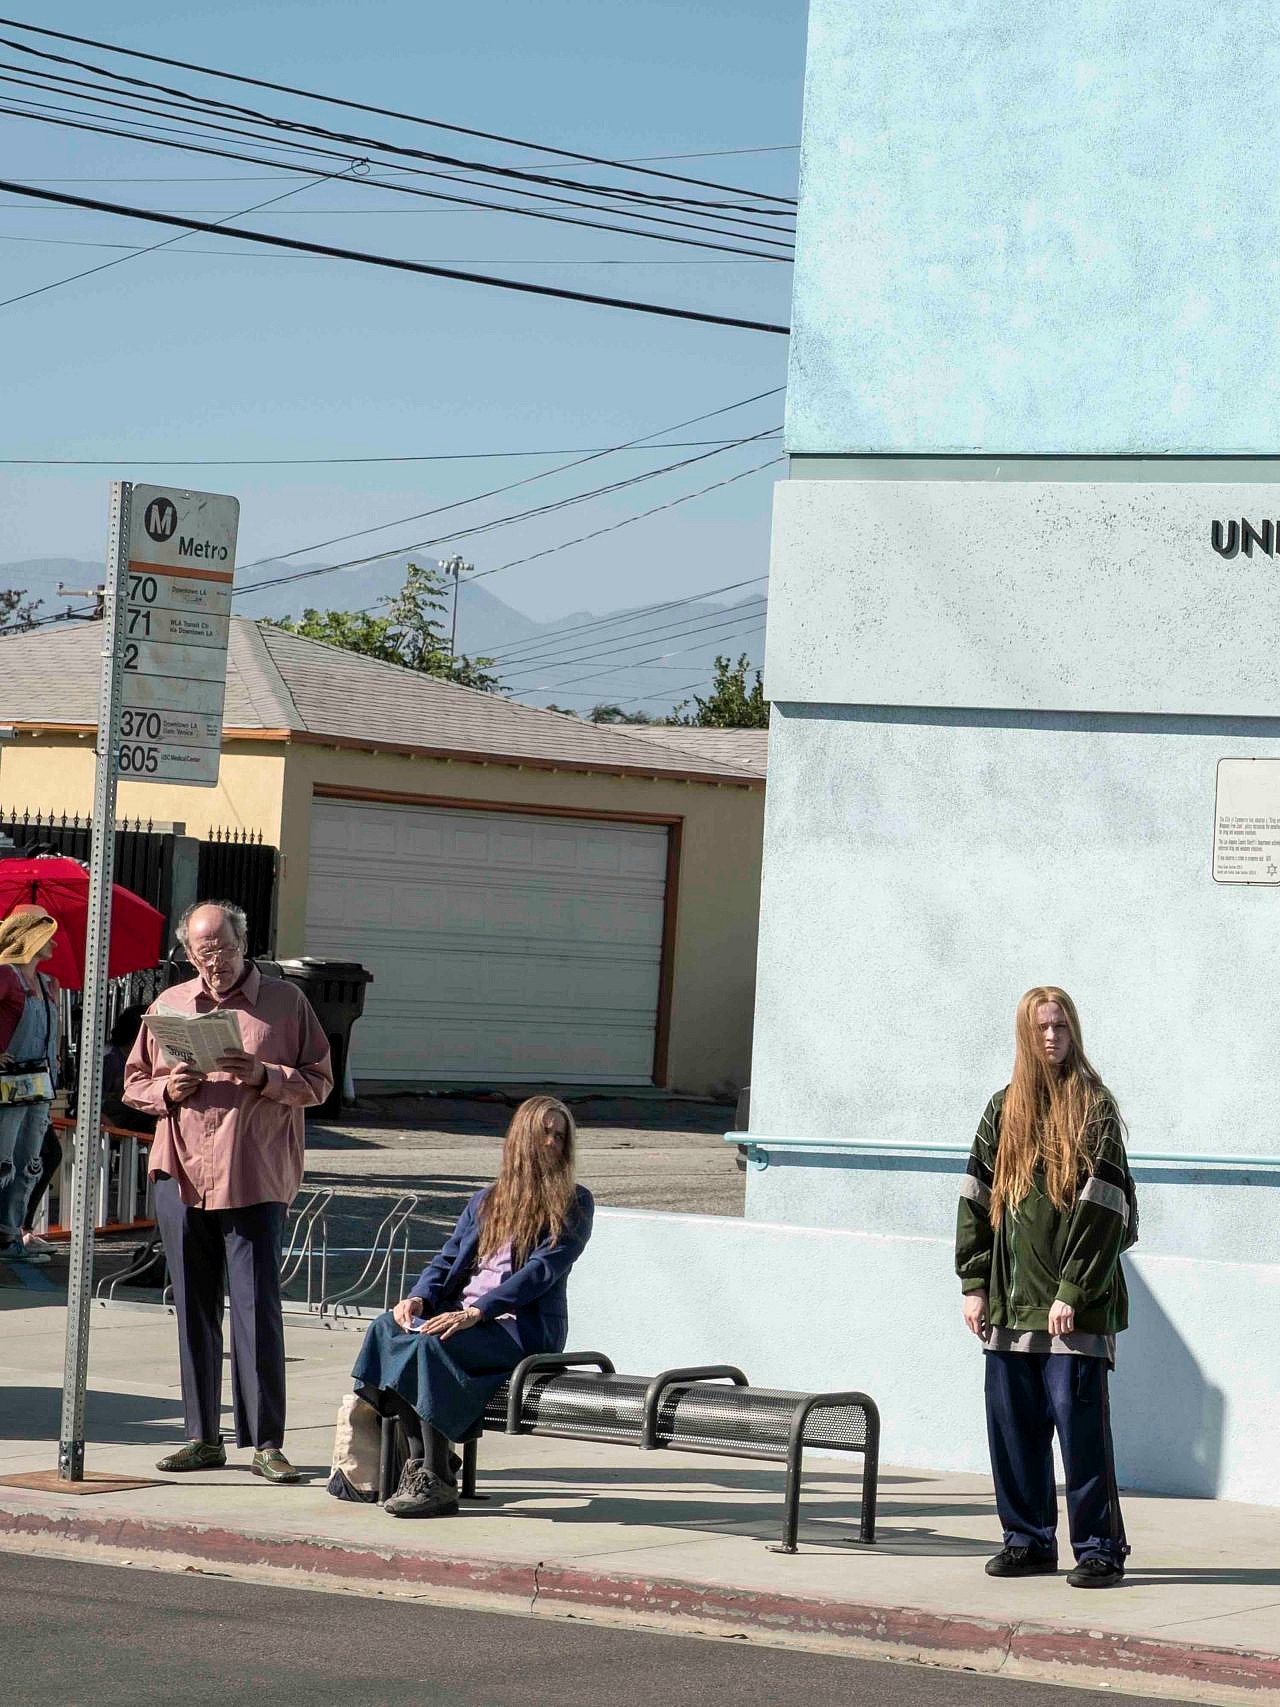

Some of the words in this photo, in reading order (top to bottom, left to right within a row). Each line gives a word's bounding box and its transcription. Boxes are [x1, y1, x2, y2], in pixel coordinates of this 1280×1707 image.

[179, 536, 227, 560] Metro
[129, 576, 157, 603] 70
[128, 609, 151, 635] 71
[124, 643, 138, 669] 2
[120, 711, 161, 739] 370
[119, 745, 160, 773] 605
